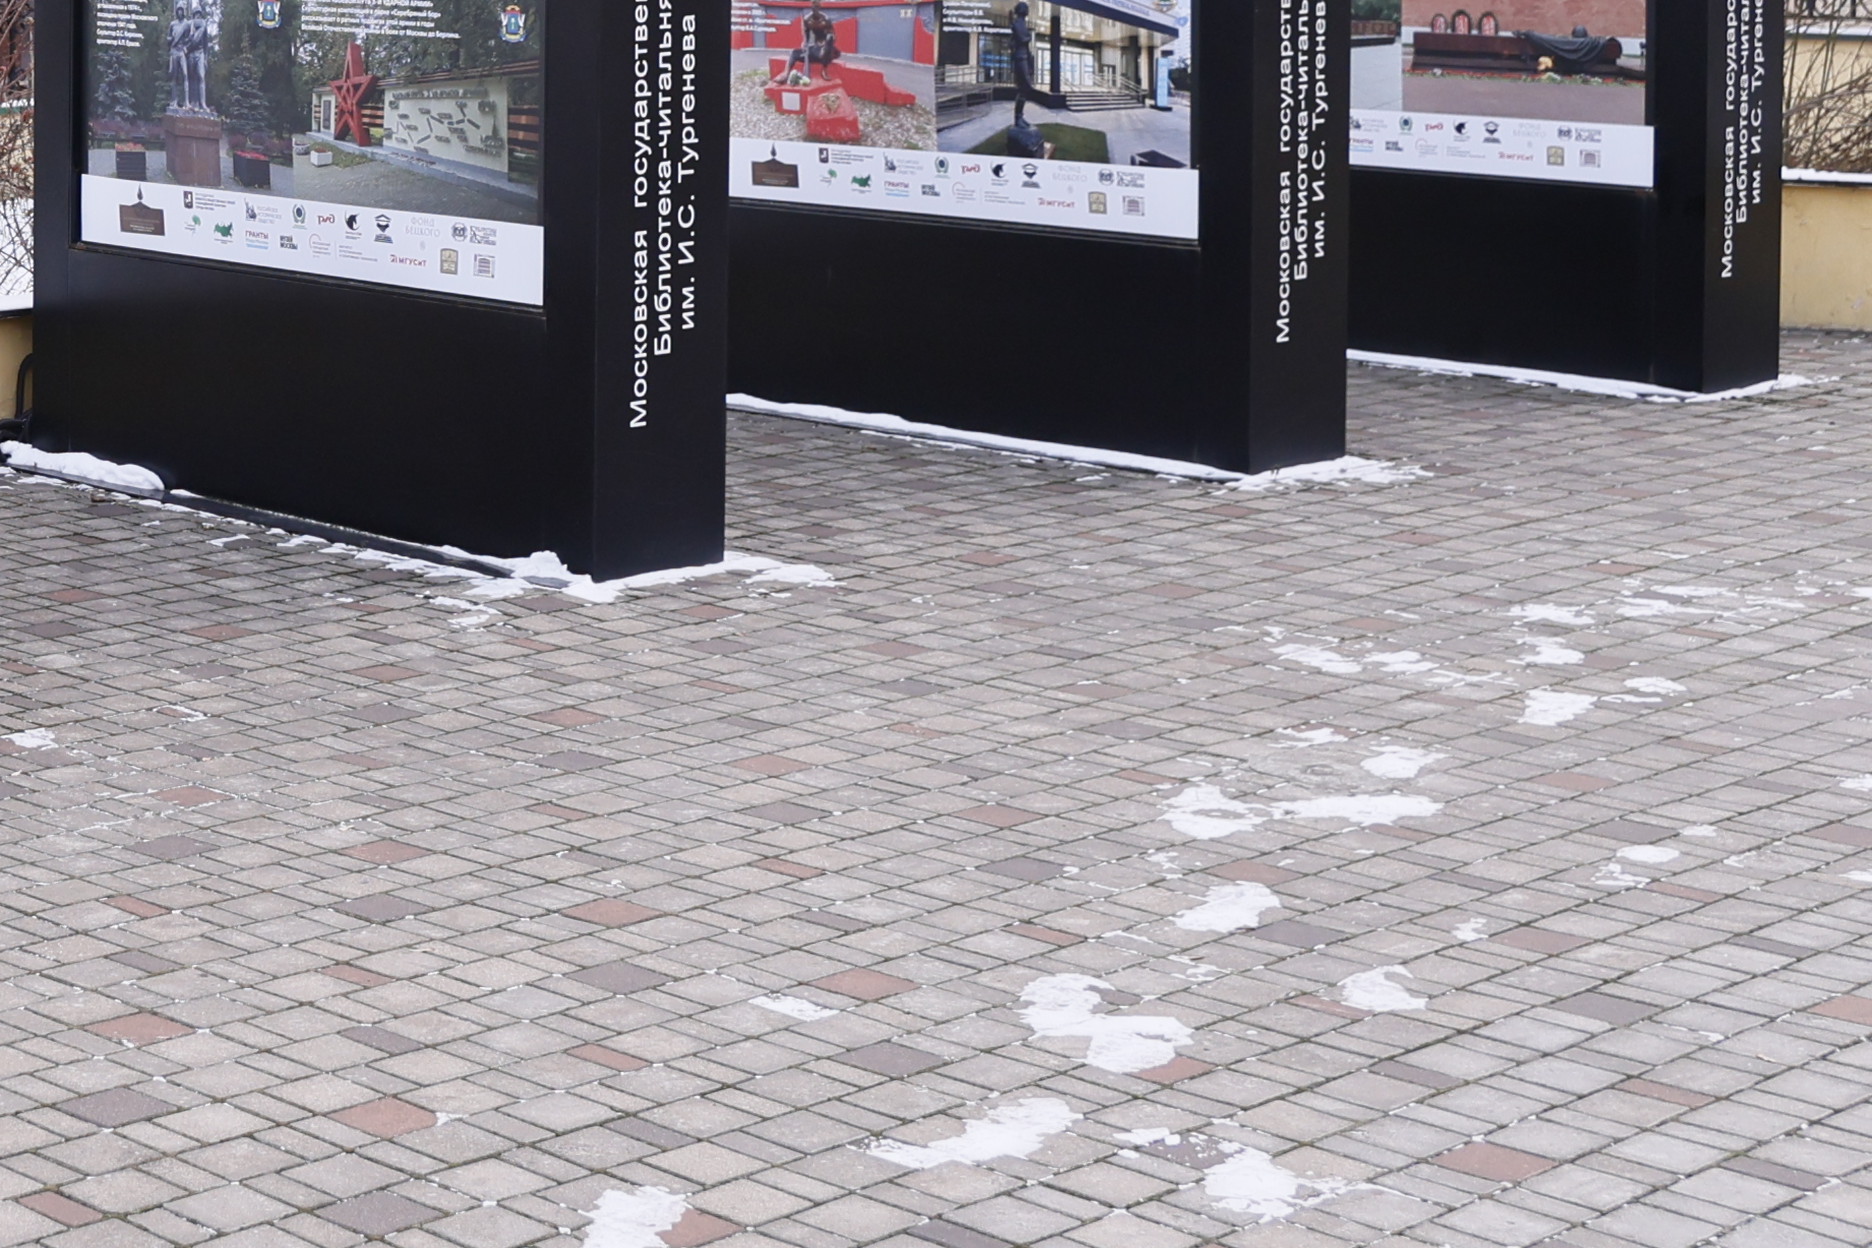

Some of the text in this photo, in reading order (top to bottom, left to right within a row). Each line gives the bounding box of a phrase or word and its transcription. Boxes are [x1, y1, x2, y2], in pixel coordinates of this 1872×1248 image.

[677, 13, 699, 331] им. И.С. Тургенева
[1311, 140, 1326, 203] И.С.
[1751, 98, 1763, 154] И.С.
[1314, 211, 1326, 259] им.
[1721, 125, 1735, 279] Московская
[1752, 161, 1762, 206] им.
[1276, 169, 1291, 344] Московская
[629, 229, 648, 429] Московская
